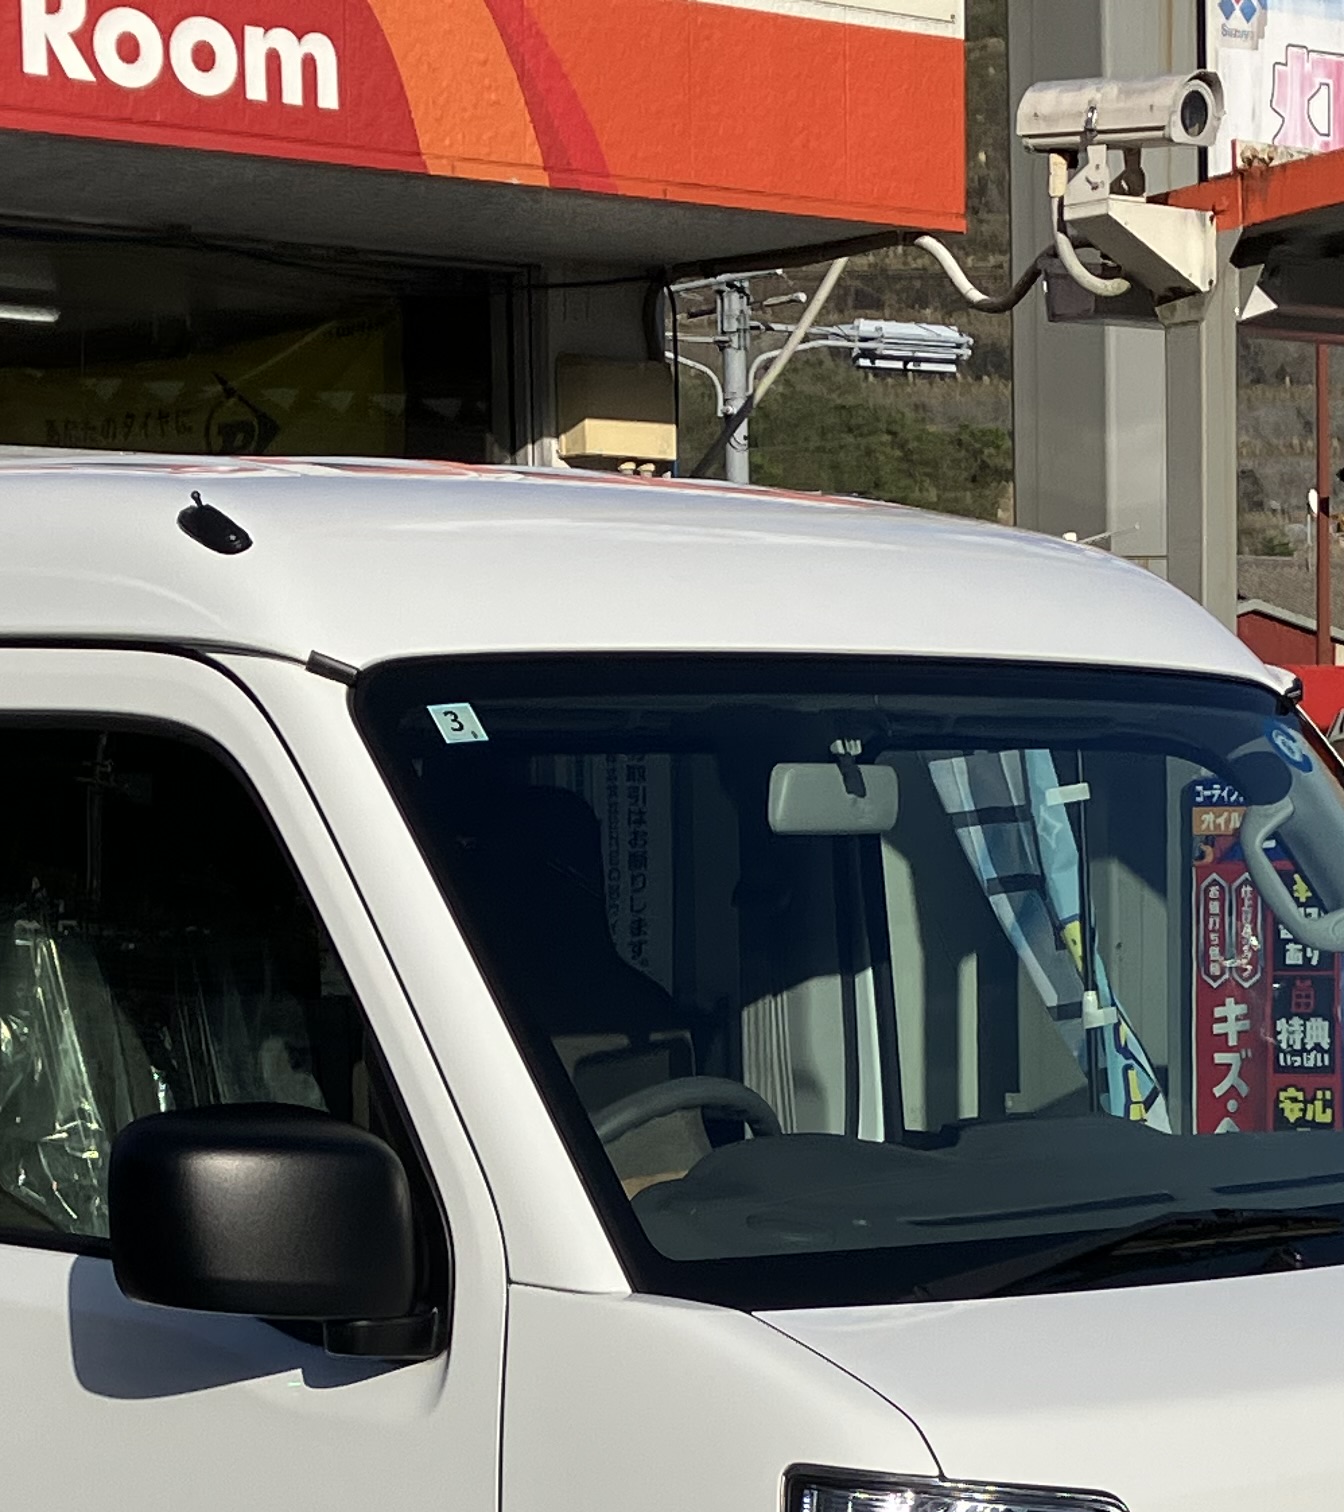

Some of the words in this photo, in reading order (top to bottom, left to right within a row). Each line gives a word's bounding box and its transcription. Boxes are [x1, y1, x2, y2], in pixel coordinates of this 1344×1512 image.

[22, 0, 341, 111] Room
[442, 710, 464, 732] 3
[626, 755, 650, 967] 取引はお断りします。
[1275, 1016, 1331, 1050] 特典
[1278, 1087, 1333, 1124] 安心
